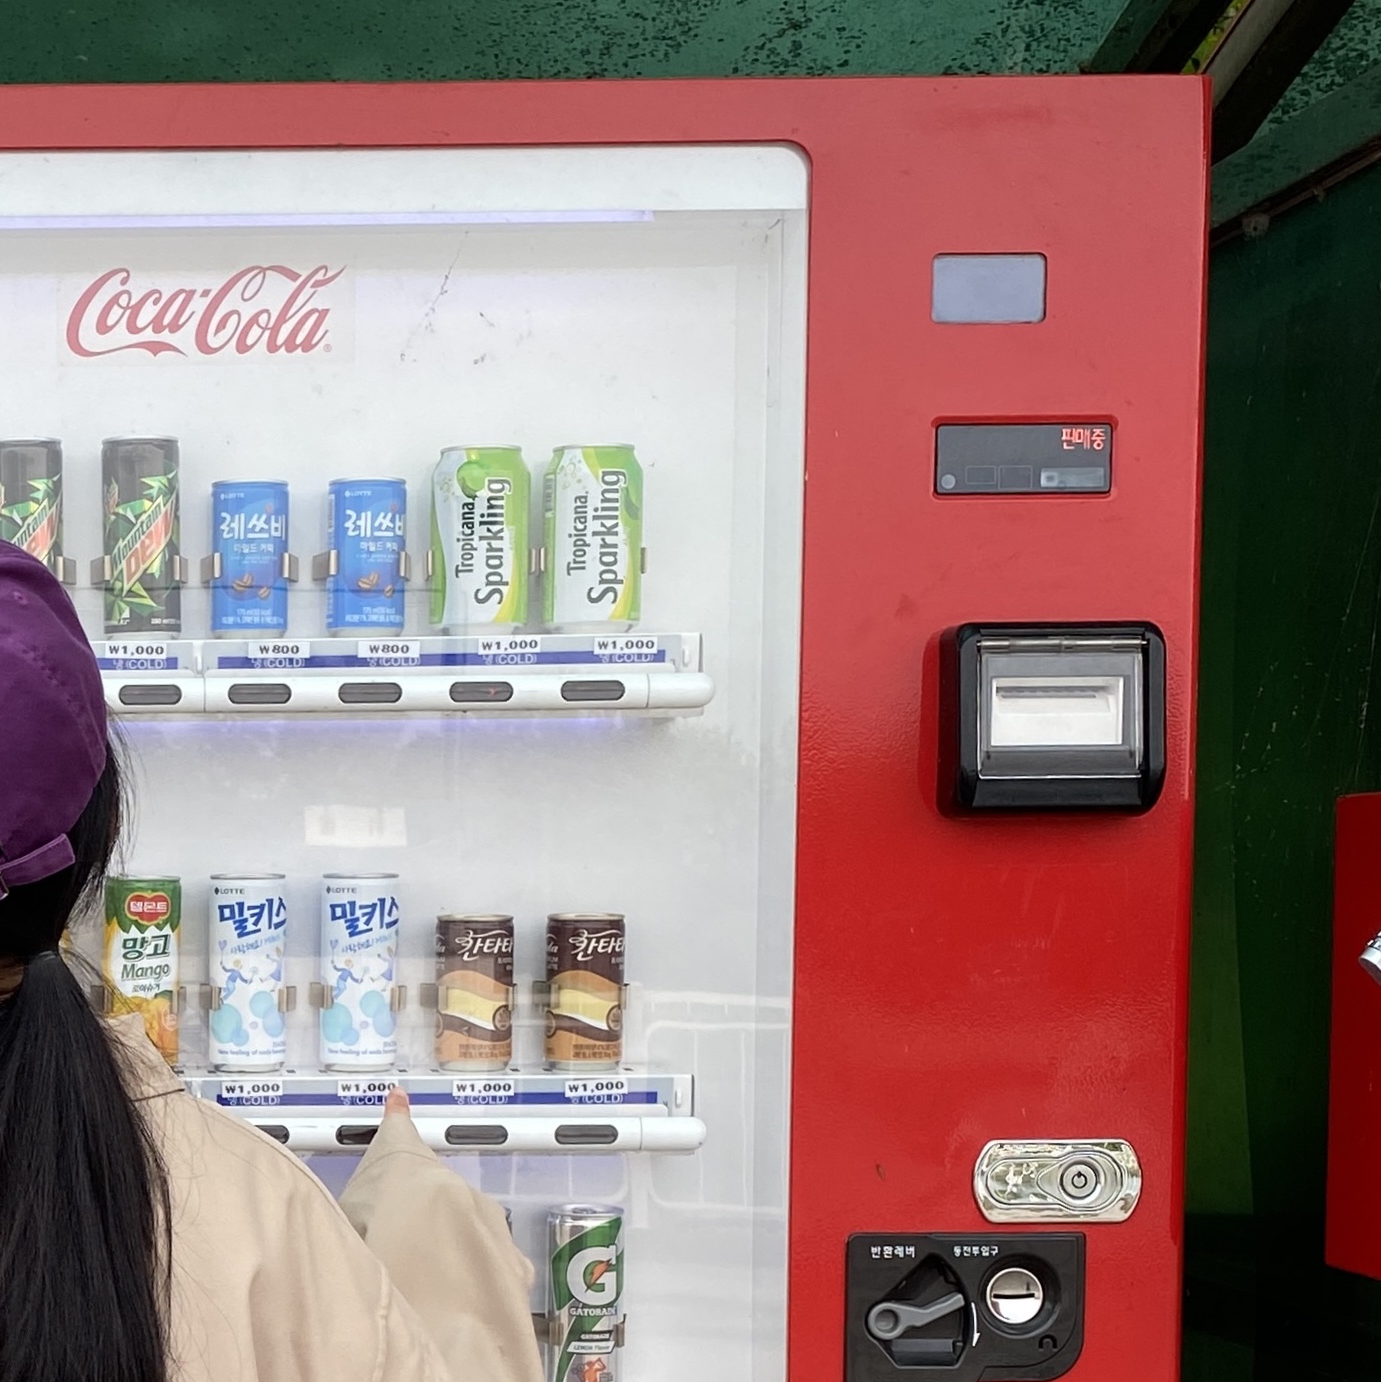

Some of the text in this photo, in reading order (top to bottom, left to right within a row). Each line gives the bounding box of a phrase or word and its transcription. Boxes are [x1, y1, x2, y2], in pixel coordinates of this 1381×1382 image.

[1061, 427, 1106, 450] 판매중
[220, 512, 285, 541] 레쓰비
[567, 492, 589, 576] Tropicana
[455, 498, 478, 578] Tropicana
[474, 478, 512, 604] Sparkling
[587, 470, 627, 604] Sparkling
[109, 645, 164, 657] ₩1,000
[259, 645, 299, 655] ₩800
[369, 644, 409, 655] ₩800
[481, 639, 538, 651] ₩1,000
[598, 639, 655, 651] ₩1,000
[218, 897, 287, 938] 밀키스
[329, 896, 399, 938] 밀키스
[122, 934, 171, 960] 망고
[121, 963, 170, 981] Mango
[225, 1083, 280, 1095] ₩1,000
[456, 1082, 512, 1093] ₩1,000
[568, 1081, 624, 1093] ₩1,000
[870, 1245, 916, 1258] 반환레버
[953, 1244, 999, 1257] 동전투입구
[567, 1244, 616, 1306] G
